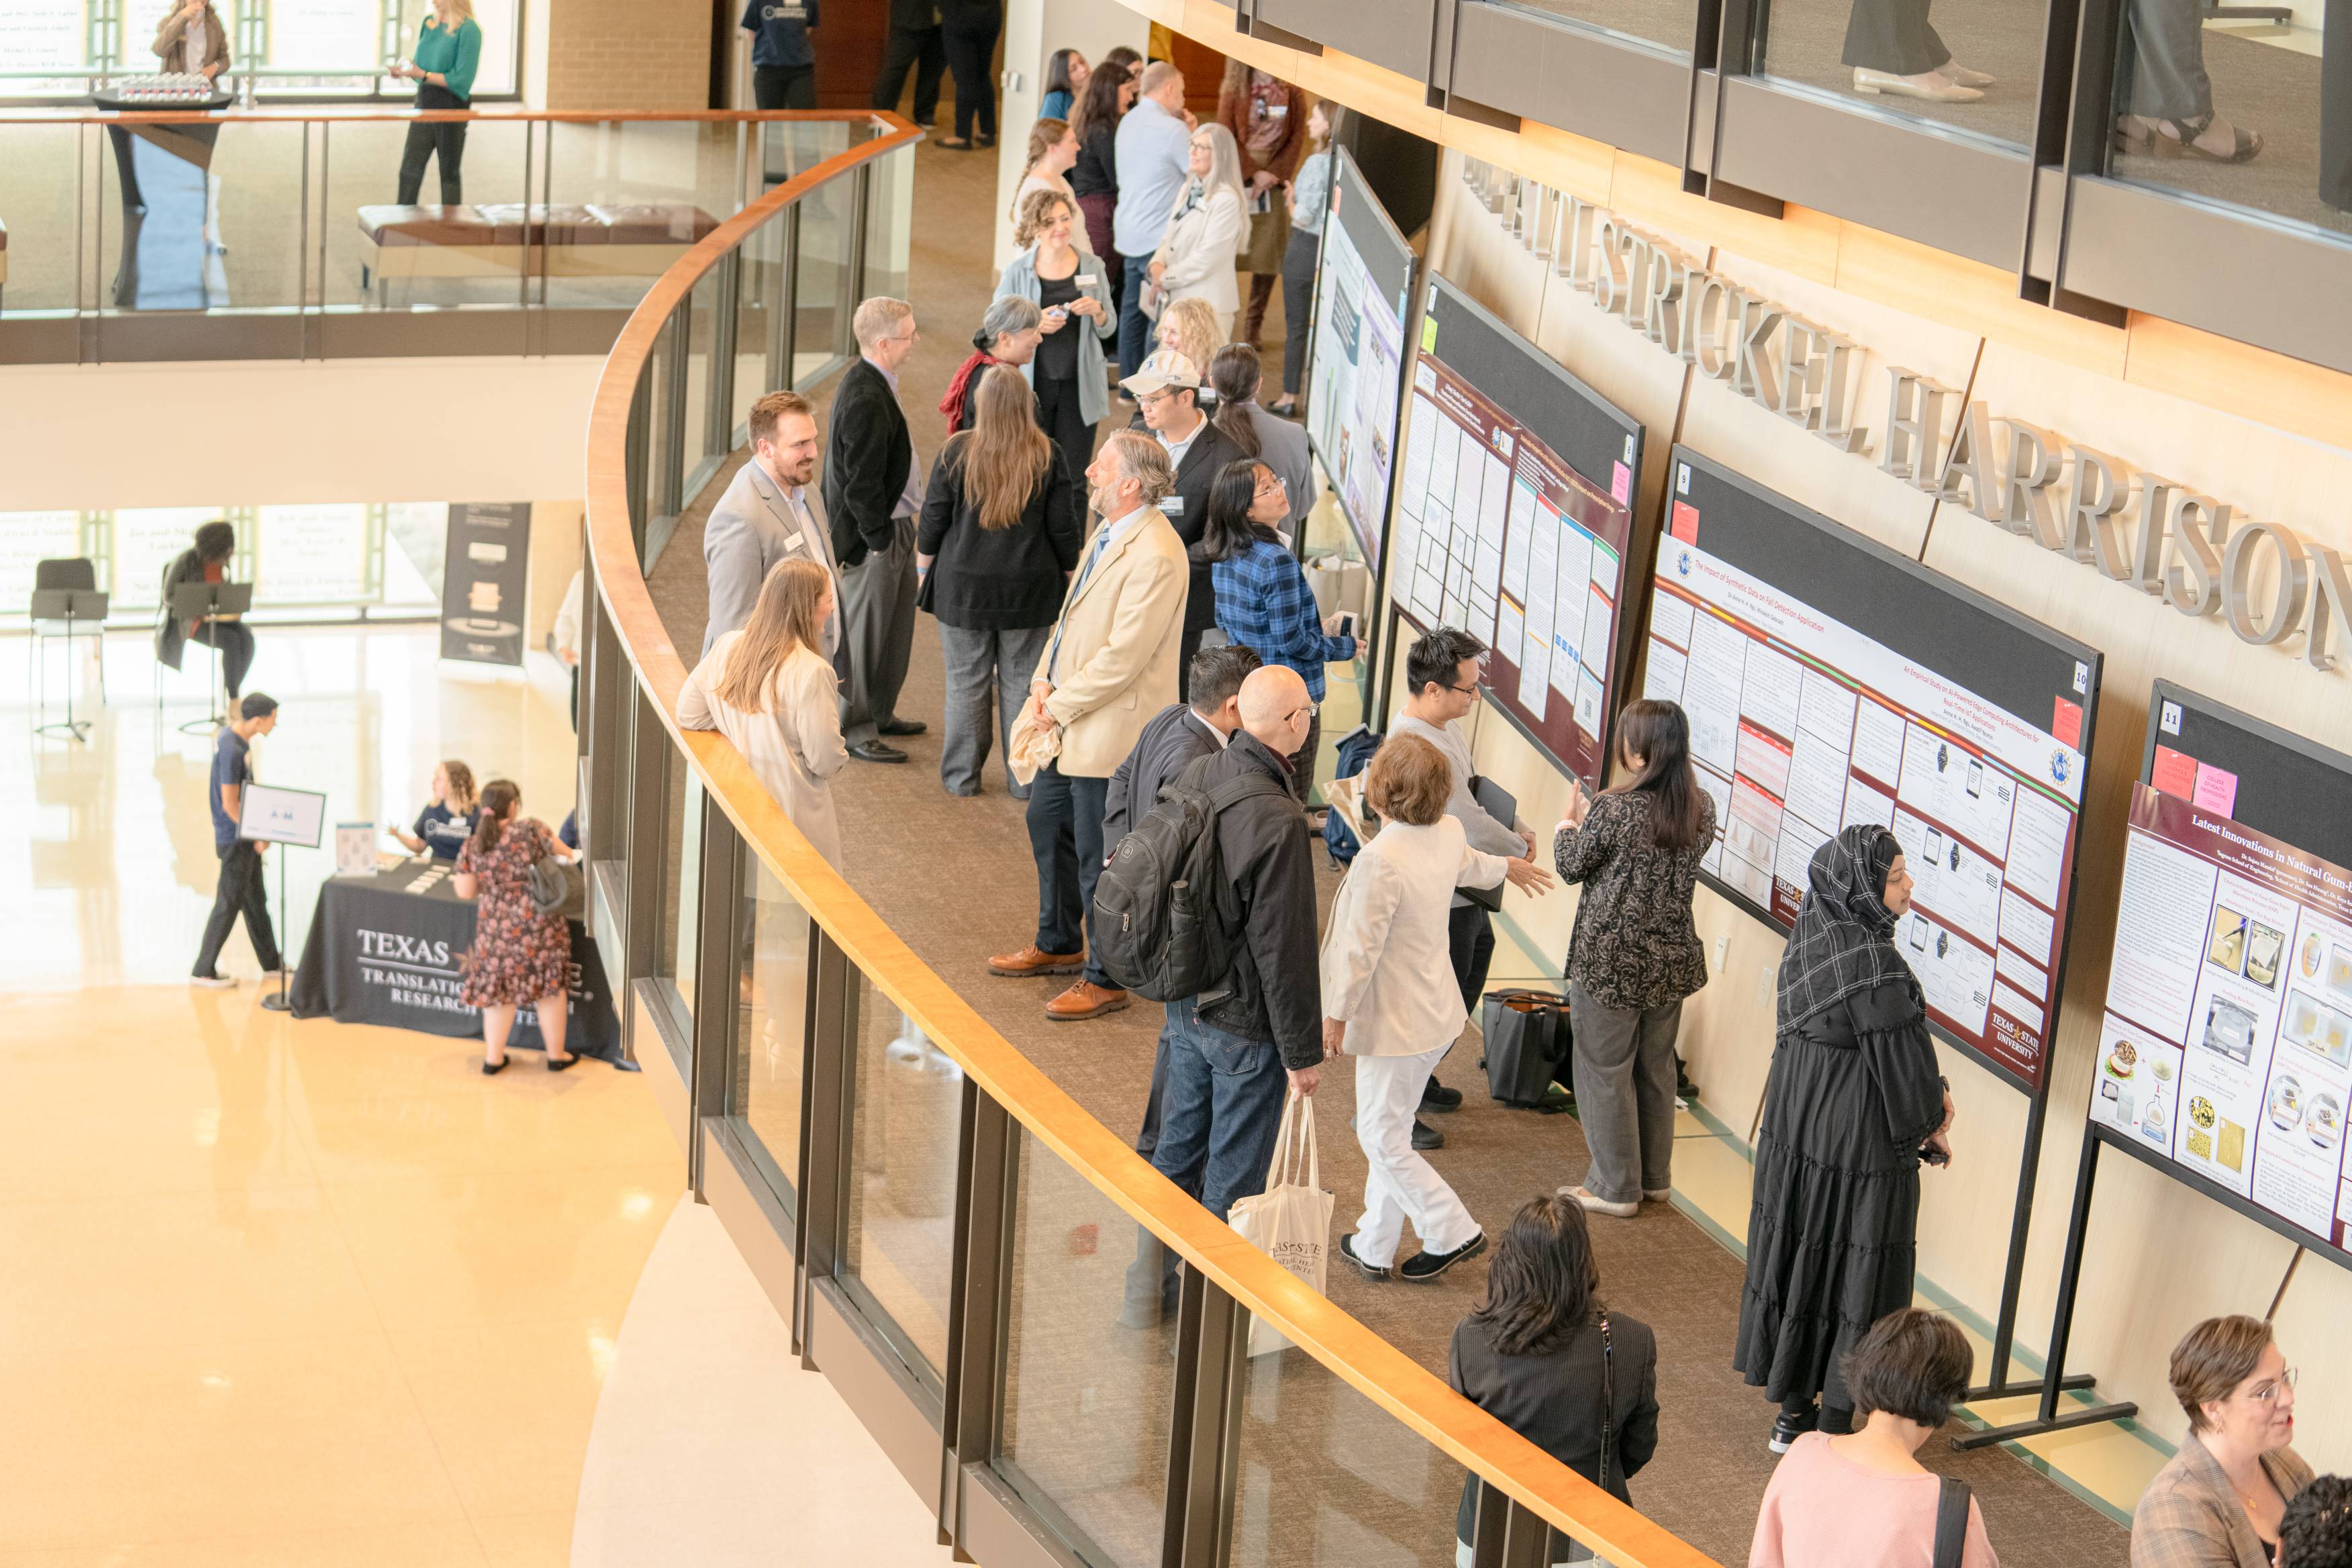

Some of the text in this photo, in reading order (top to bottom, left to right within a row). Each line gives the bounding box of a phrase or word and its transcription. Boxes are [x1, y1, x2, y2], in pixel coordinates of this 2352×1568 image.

[1594, 218, 1869, 454] STRICKEL
[1681, 475, 1686, 483] 9
[1704, 564, 1720, 579] Impact
[1726, 575, 1748, 593] Synthetic
[1748, 587, 1759, 599] Data
[1766, 596, 1774, 607] Fall
[1774, 601, 1797, 619] Detection
[1797, 614, 1825, 634] Application
[2077, 673, 2086, 684] 10
[1904, 665, 1910, 673] An
[1910, 669, 1929, 683] Empirical
[1929, 679, 1941, 691] Study
[1949, 689, 1973, 705] AI-Powered
[1973, 701, 1982, 712] Edge
[1983, 707, 2004, 726] Computing
[2005, 720, 2032, 740] Architectures
[1943, 697, 1965, 714] Real-Time
[1973, 714, 1996, 732] Applications
[2165, 712, 2177, 725] 11
[2165, 757, 2184, 767] COLLEGE
[2200, 786, 2227, 801] PROFESSIONS
[2207, 775, 2224, 786] COLLEGE
[2210, 783, 2225, 792] HEALTH
[2192, 814, 2221, 835] Latest
[2222, 826, 2274, 859] Innovations
[2275, 850, 2285, 863] in
[2286, 856, 2322, 879] Natural
[1776, 877, 1794, 895] TEXAS
[2232, 856, 2244, 868] School
[2294, 884, 2308, 894] Health
[357, 928, 450, 966] TEXAS
[360, 967, 468, 995] TRANSLATIO
[1993, 1012, 2039, 1051] TEXAS STATE
[1997, 1032, 2033, 1059] UNIVERSITY
